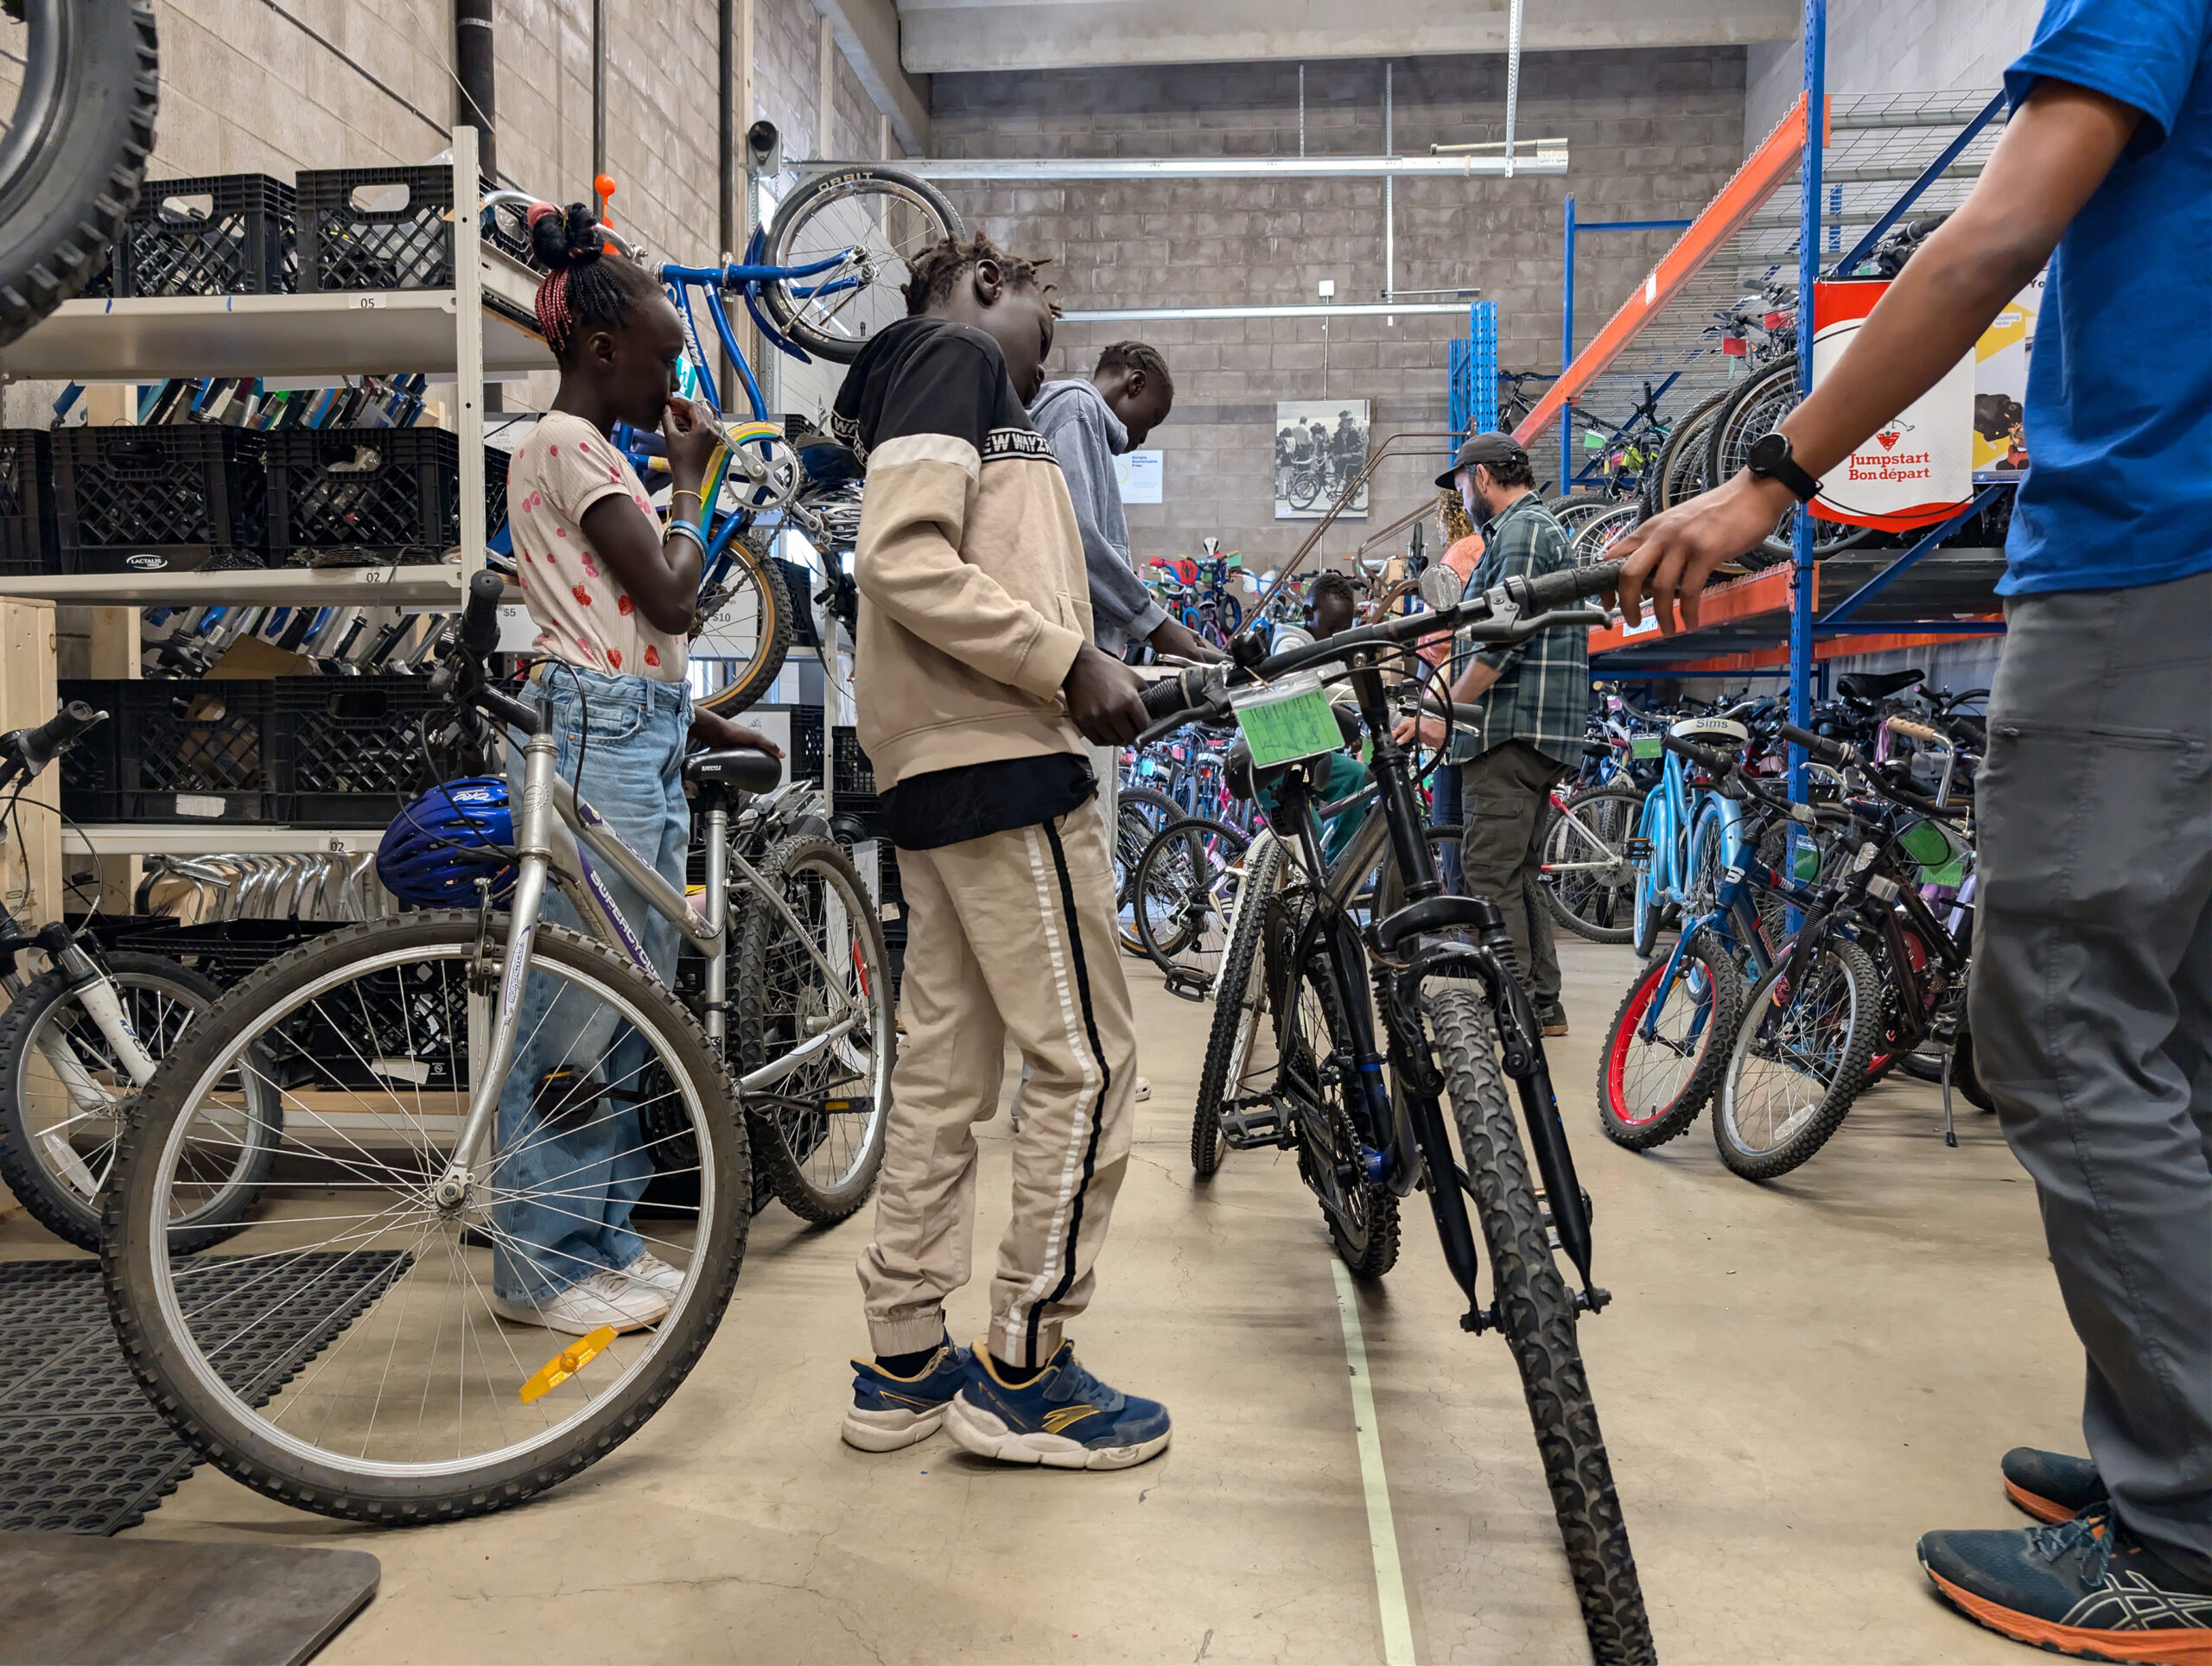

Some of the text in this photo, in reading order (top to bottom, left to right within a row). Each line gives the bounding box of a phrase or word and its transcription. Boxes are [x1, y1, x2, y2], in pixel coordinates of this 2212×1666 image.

[818, 172, 874, 192] ORBIT
[360, 298, 375, 308] 05
[677, 304, 704, 367] RAMPAR
[1849, 452, 1929, 468] Jumpstart
[1848, 467, 1930, 482] Bon départ
[366, 572, 381, 583] 02
[503, 607, 516, 617] $5
[1696, 719, 1728, 728] Sims
[330, 842, 345, 852] 02
[507, 942, 525, 1004] SUPERCYCLE
